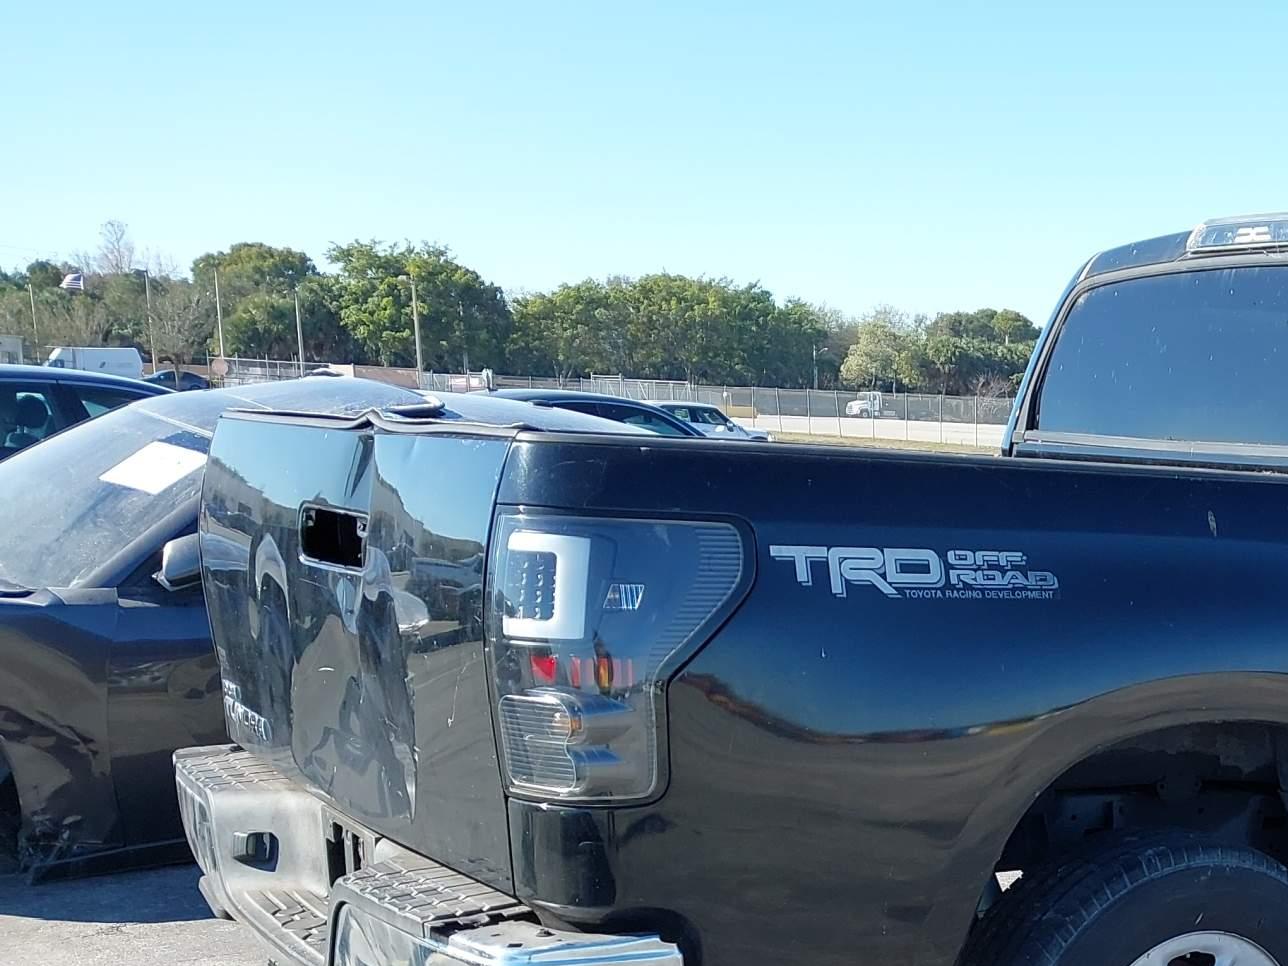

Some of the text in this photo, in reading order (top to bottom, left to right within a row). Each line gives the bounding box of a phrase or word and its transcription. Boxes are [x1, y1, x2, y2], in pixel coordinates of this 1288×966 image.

[947, 550, 1027, 569] OFF
[769, 545, 945, 598] TRD
[949, 569, 1059, 589] ROAD
[904, 589, 1054, 599] TOYOTA RACING DEVELOPMENT
